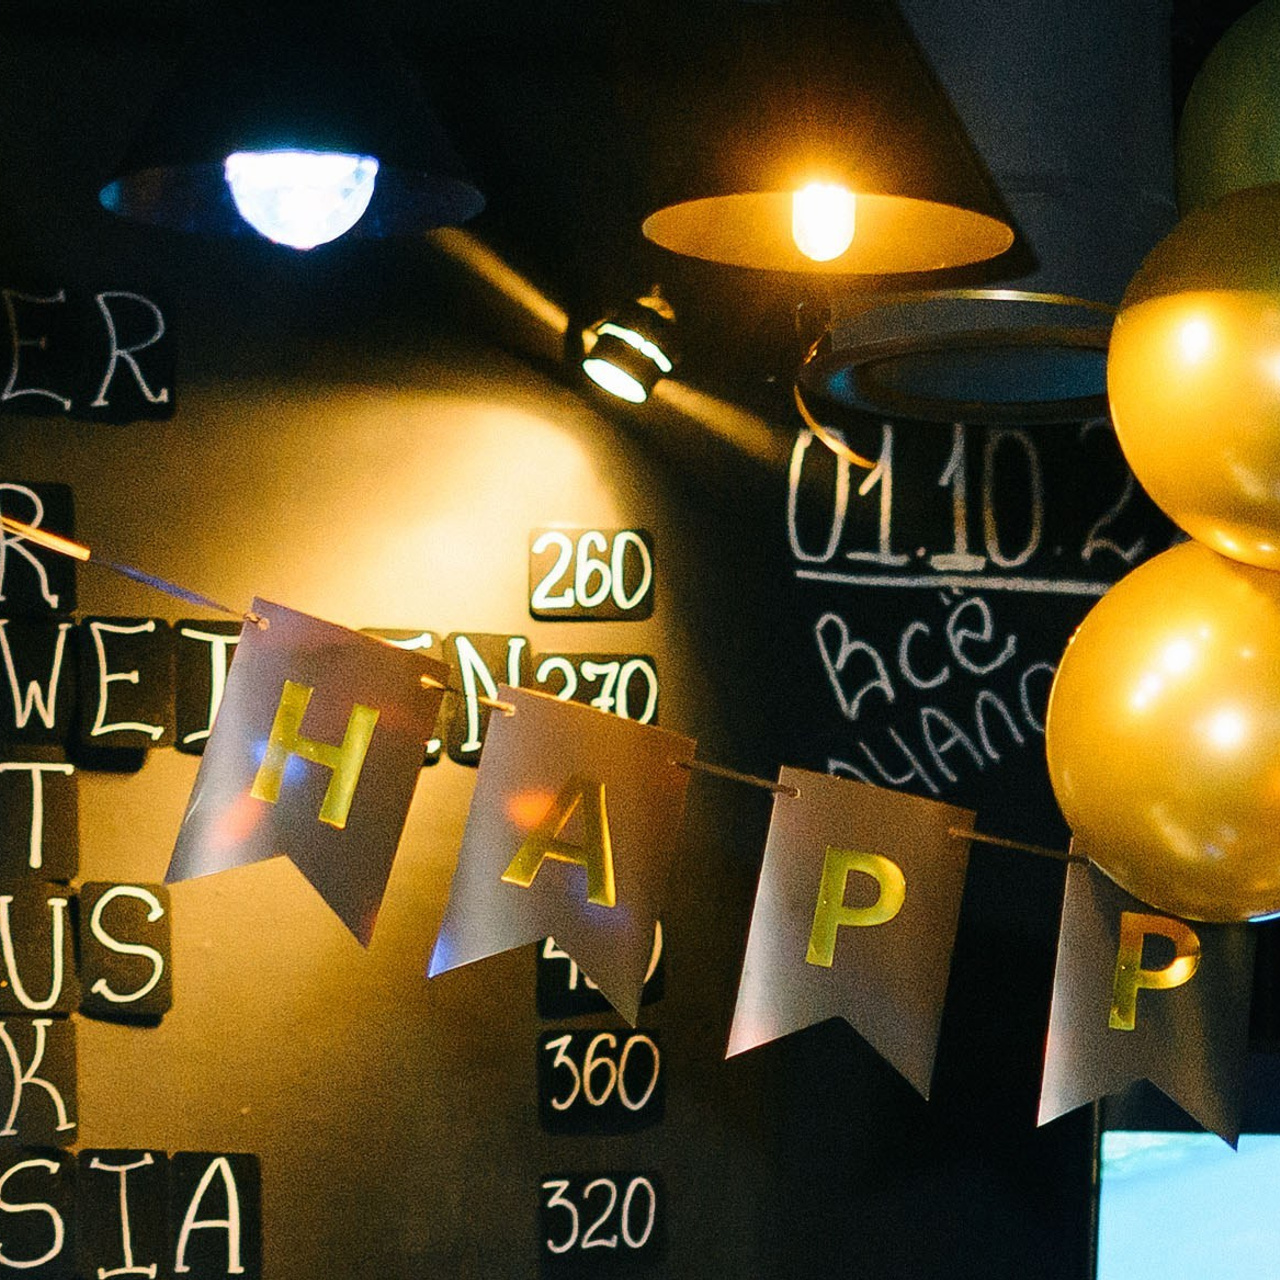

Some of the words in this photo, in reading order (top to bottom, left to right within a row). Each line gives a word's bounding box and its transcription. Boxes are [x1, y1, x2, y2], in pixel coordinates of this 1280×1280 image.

[0, 290, 170, 409] ER
[531, 530, 653, 609] 260
[0, 763, 74, 868] T
[0, 885, 165, 1010] US
[544, 1033, 660, 1110] 360
[0, 1152, 246, 1280] SIA
[542, 1177, 657, 1254] 320
